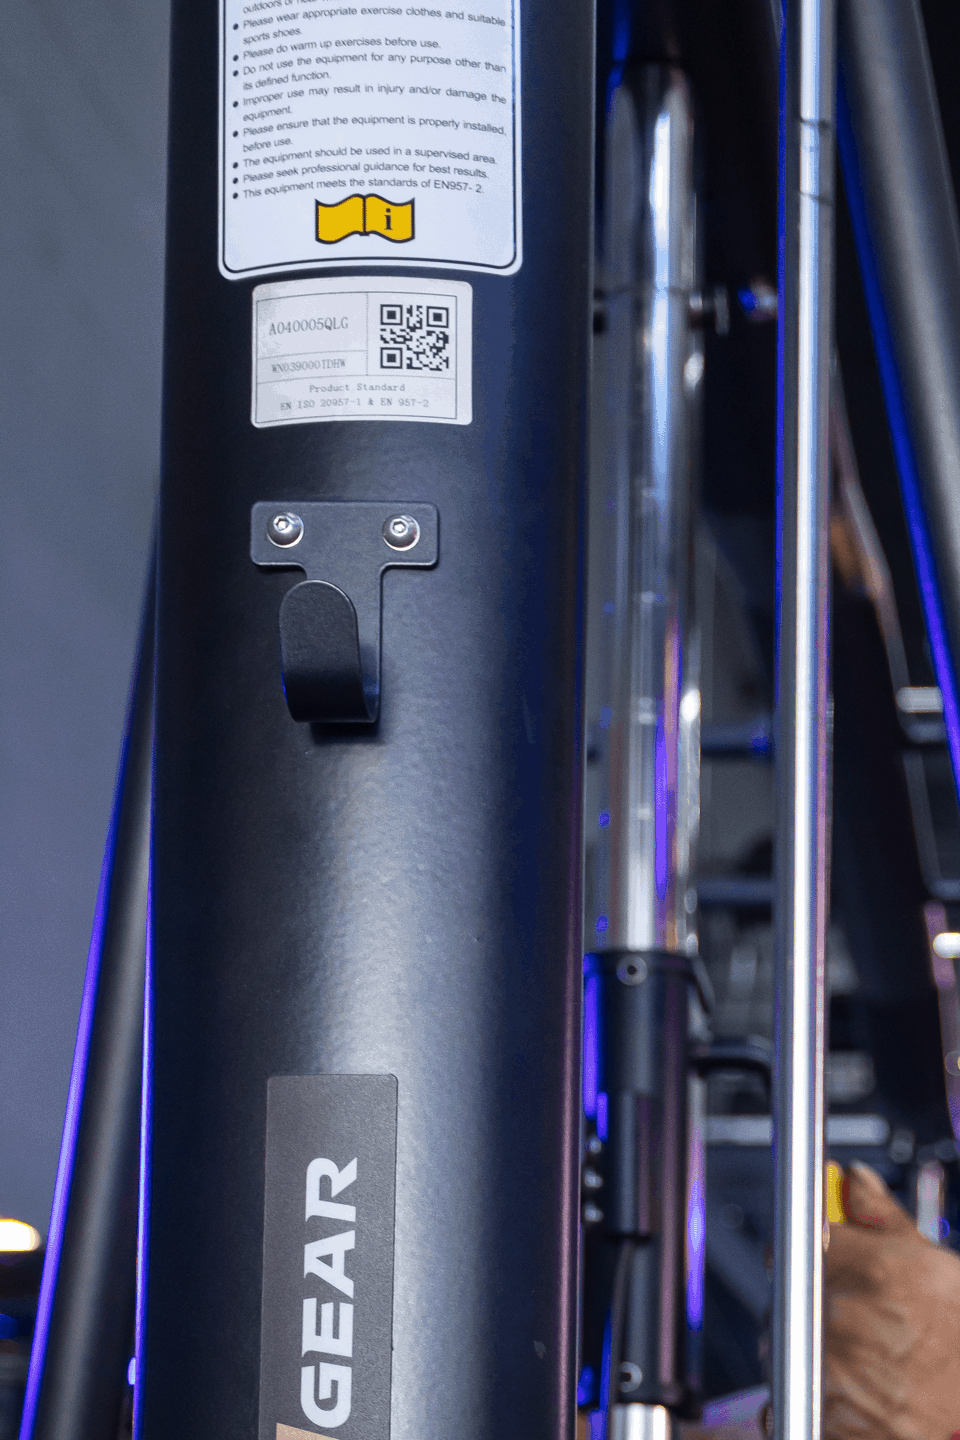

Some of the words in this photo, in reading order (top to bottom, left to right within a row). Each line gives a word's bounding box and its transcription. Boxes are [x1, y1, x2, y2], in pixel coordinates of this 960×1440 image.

[243, 0, 282, 14] outdoors
[243, 16, 274, 29] Please
[276, 12, 299, 22] wear
[302, 7, 357, 20] appropriate
[360, 6, 402, 15] exercise
[406, 7, 442, 18] clothes
[445, 11, 465, 20] and
[467, 13, 506, 27] suitable
[243, 32, 270, 45] sports
[272, 27, 303, 39] shoes.
[243, 47, 274, 60] Please
[276, 44, 288, 54] do
[290, 40, 317, 51] warm
[319, 40, 332, 50] up
[335, 37, 382, 47] exercises
[385, 37, 417, 47] before
[420, 40, 441, 49] use.
[243, 65, 256, 75] Do
[259, 61, 274, 72] not
[276, 60, 294, 69] use
[297, 57, 312, 66] the
[315, 53, 368, 65] equipment
[371, 52, 384, 61] for
[388, 54, 406, 64] any
[410, 55, 452, 65] purpose
[455, 58, 482, 68] other
[484, 61, 507, 73] than
[243, 82, 253, 91] its
[255, 75, 289, 88] defined
[291, 71, 332, 82] function.
[243, 91, 284, 106] Improper
[287, 89, 304, 99] use
[308, 87, 329, 97] may
[333, 84, 361, 94] result
[364, 84, 374, 93] in
[377, 84, 405, 95] injury
[409, 85, 442, 95] and/or
[445, 88, 487, 101] damage
[491, 93, 507, 104] the
[243, 105, 293, 122] equipment.
[243, 125, 274, 137] Please
[276, 120, 309, 131] ensure
[312, 117, 330, 126] that
[332, 116, 348, 125] the
[351, 115, 405, 126] equipment
[407, 116, 416, 124] is
[419, 118, 460, 130] properly
[243, 140, 272, 153] before
[273, 137, 293, 147] use.
[243, 158, 260, 167] The
[262, 150, 312, 164] equipment
[314, 147, 347, 157] should
[350, 147, 362, 156] be
[365, 146, 390, 155] used
[393, 146, 402, 155] in
[415, 148, 470, 161] supervised
[473, 154, 498, 165] area.
[243, 171, 274, 183] Please
[276, 167, 299, 178] seek
[301, 162, 360, 176] professional
[363, 162, 409, 173] guidance
[413, 162, 426, 172] for
[429, 164, 451, 175] best
[453, 167, 489, 179] results.
[243, 188, 262, 199] This
[264, 180, 314, 195] equipment
[316, 178, 347, 188] meets
[349, 178, 365, 186] the
[368, 178, 418, 188] standards
[421, 179, 431, 188] of
[268, 316, 348, 336] A040005QLG
[309, 384, 350, 393] Product
[356, 383, 406, 391] Standard
[280, 401, 292, 411] EN
[297, 399, 315, 409] ISO
[380, 398, 393, 406] EN
